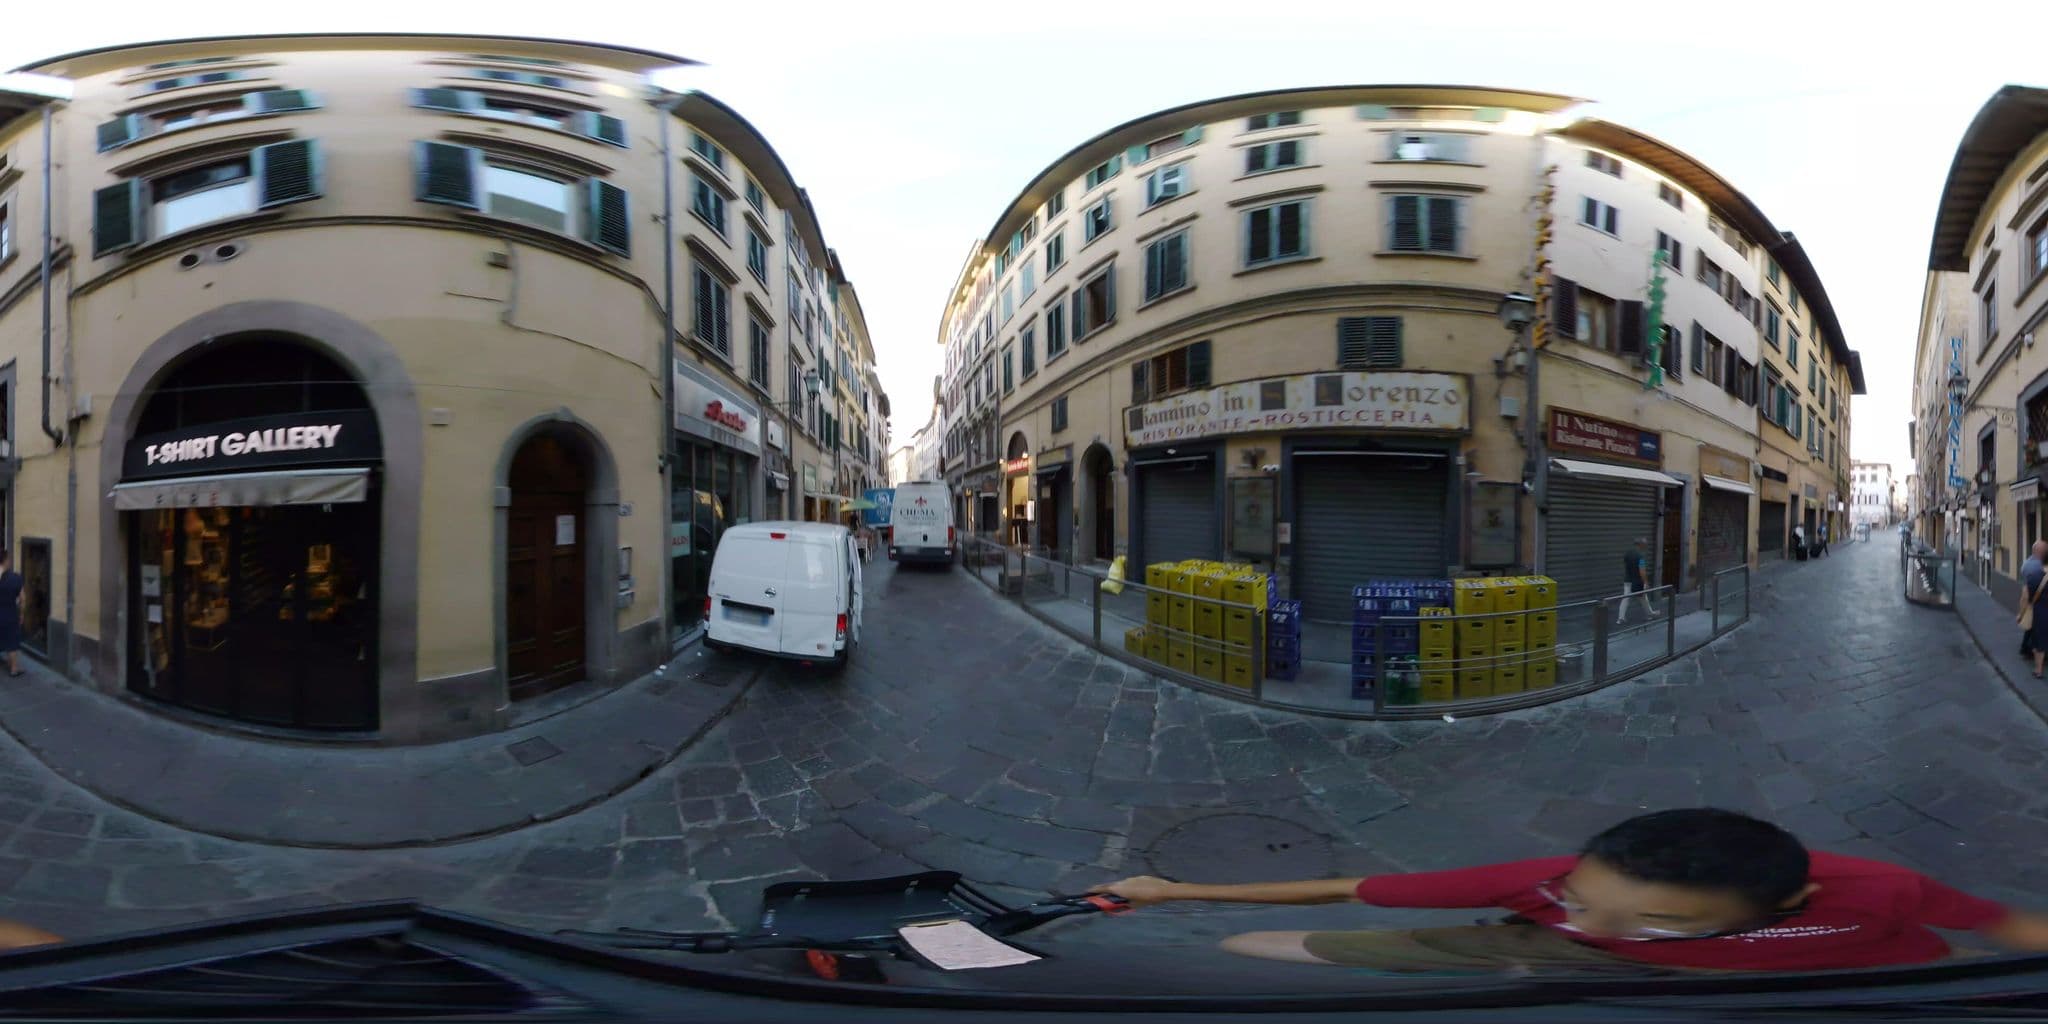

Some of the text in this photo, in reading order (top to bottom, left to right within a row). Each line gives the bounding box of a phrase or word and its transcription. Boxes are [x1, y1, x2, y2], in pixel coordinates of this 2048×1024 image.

[1130, 401, 1210, 431] iannino
[1223, 391, 1244, 412] in
[1948, 337, 1963, 483] RISRANTE
[145, 424, 342, 466] T-SHIRT GALLERY
